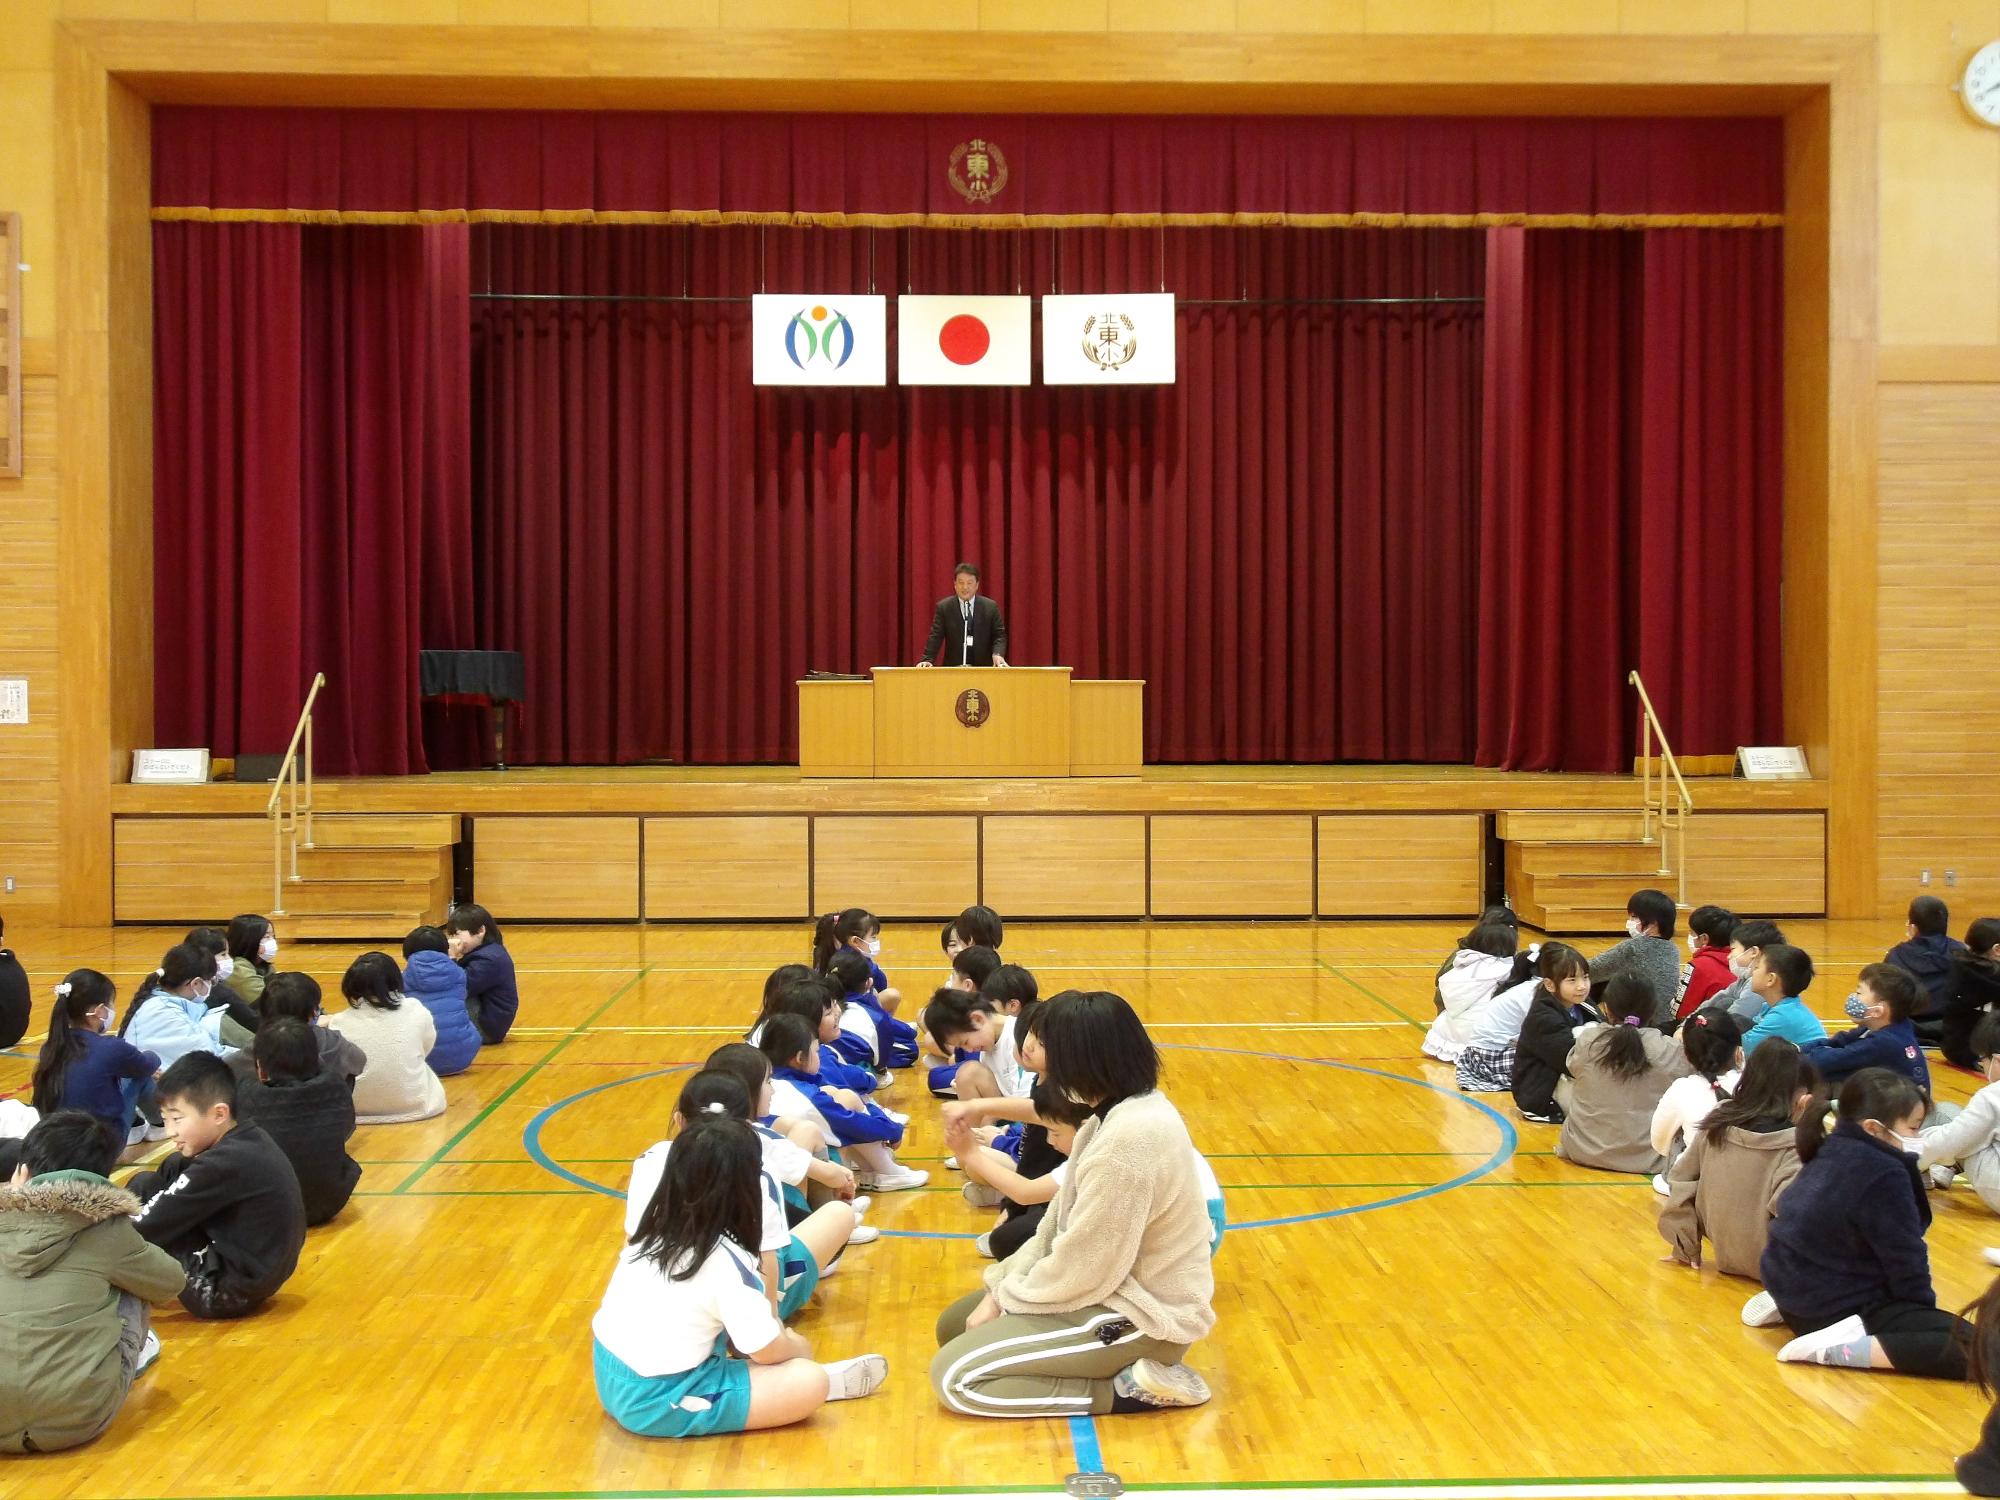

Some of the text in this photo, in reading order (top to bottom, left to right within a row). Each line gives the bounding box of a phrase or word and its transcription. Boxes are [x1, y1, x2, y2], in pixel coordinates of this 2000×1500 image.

[966, 138, 990, 191] 北東小
[1098, 312, 1122, 362] 北東小
